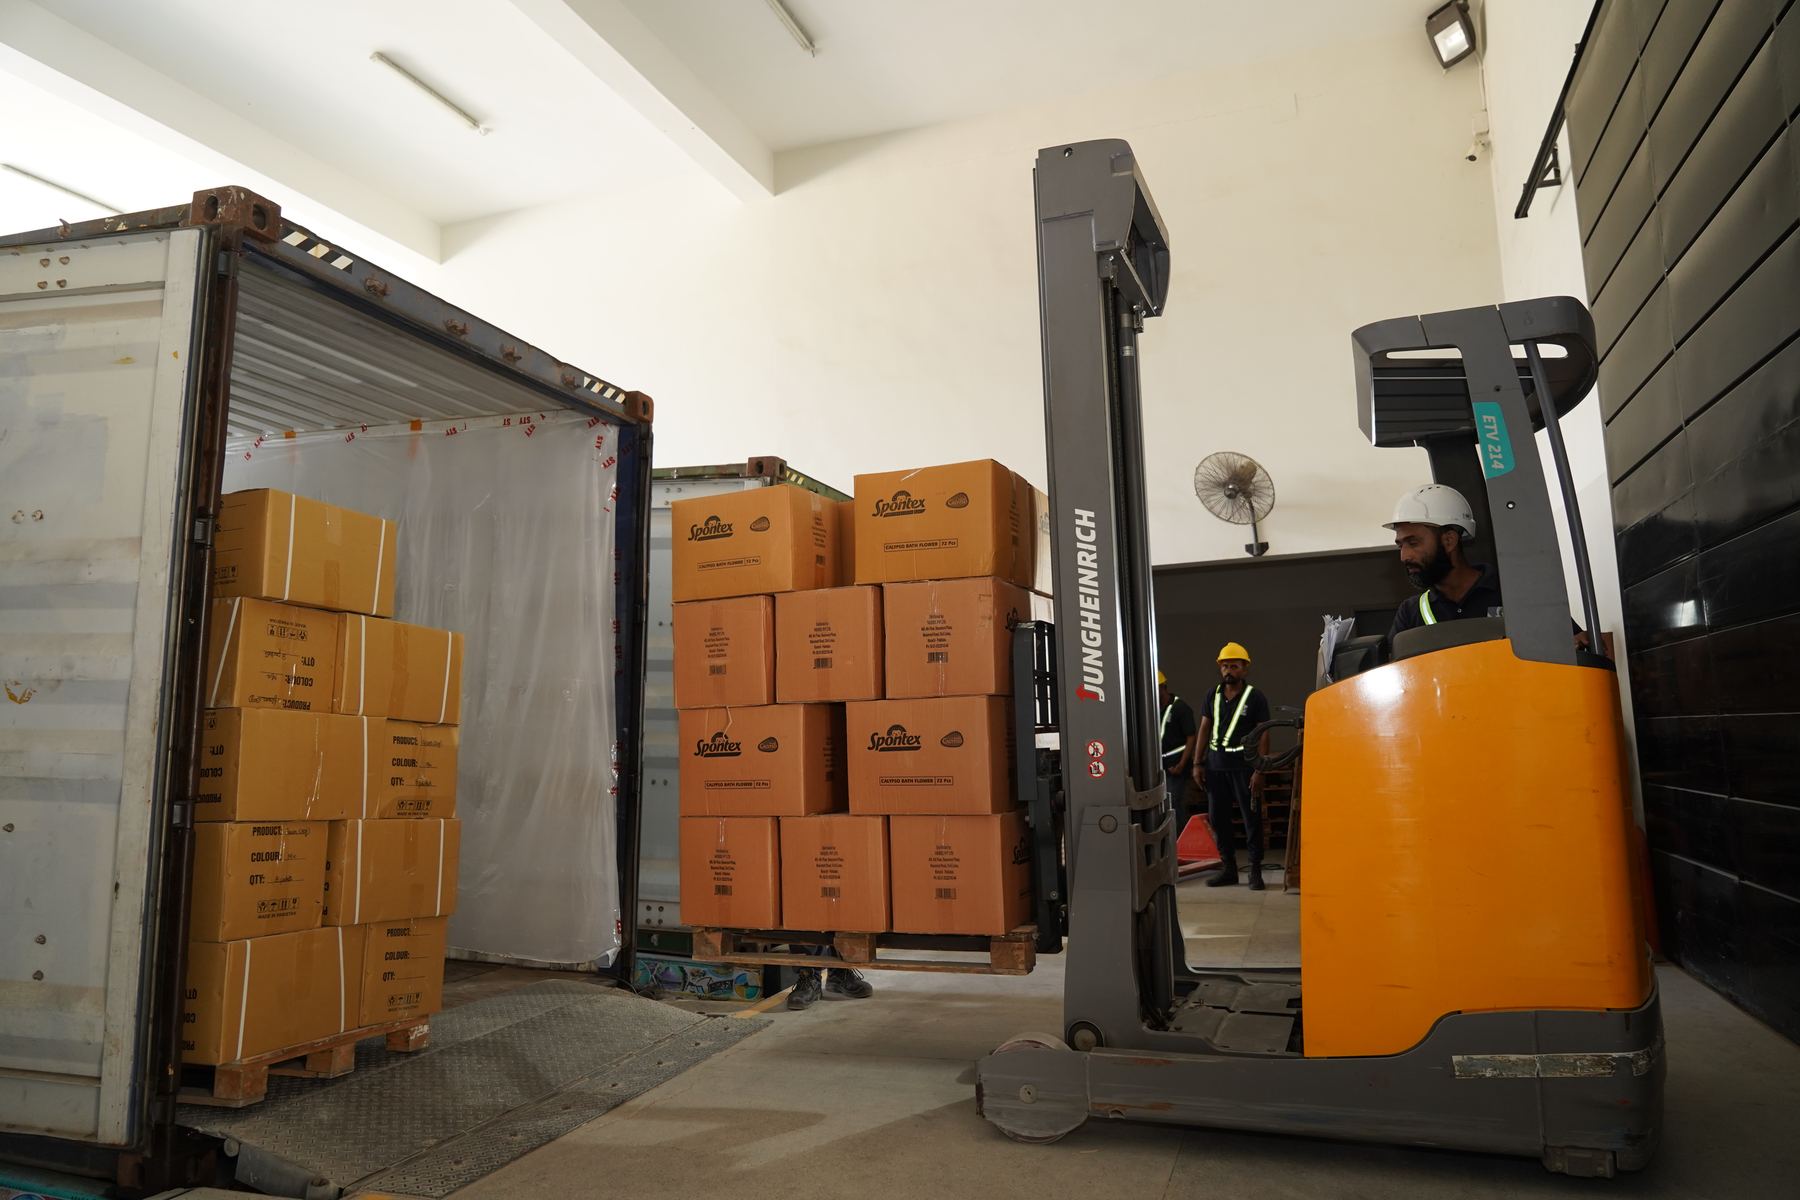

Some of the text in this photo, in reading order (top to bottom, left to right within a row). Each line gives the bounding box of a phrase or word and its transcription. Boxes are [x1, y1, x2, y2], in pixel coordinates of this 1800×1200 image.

[1482, 415, 1504, 470] ETV 214
[872, 498, 925, 517] Spontex
[688, 522, 733, 541] Spontex
[1075, 508, 1104, 702] JUNGHEINRICH
[302, 656, 315, 668] QTY:
[868, 732, 921, 751] Spontex
[209, 744, 224, 756] QTY:
[694, 739, 742, 757] Spontex
[392, 758, 418, 768] COLOUR:
[200, 768, 222, 778] COLOU
[390, 776, 404, 786] QTY:
[250, 874, 264, 885] QTY:
[384, 951, 410, 960] COLOUR:
[382, 972, 396, 982] QTY:
